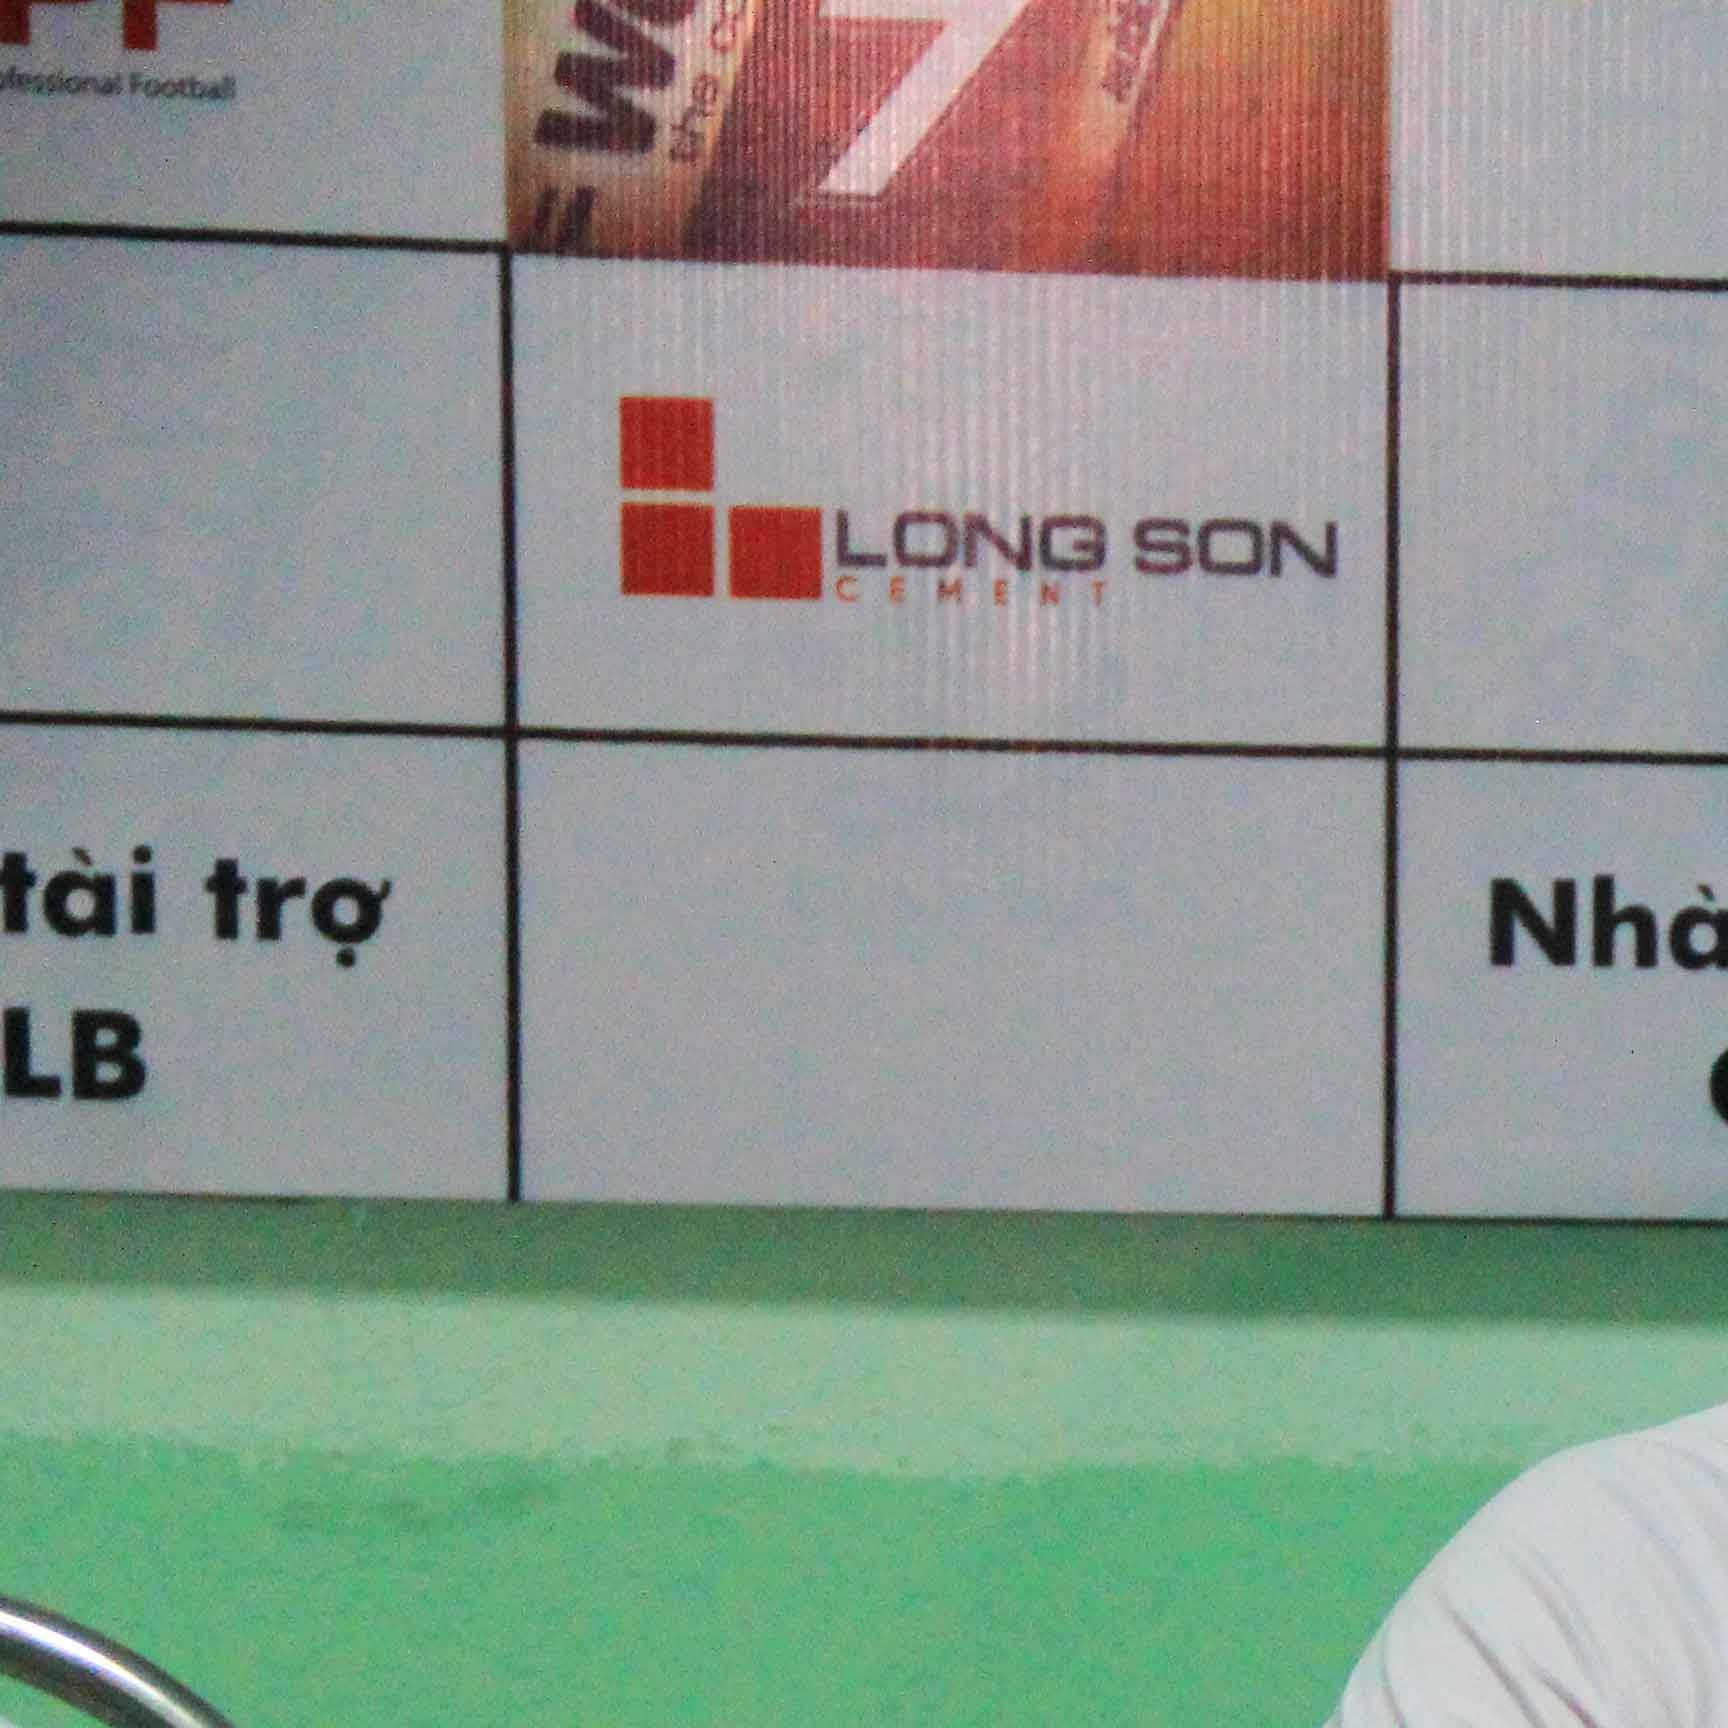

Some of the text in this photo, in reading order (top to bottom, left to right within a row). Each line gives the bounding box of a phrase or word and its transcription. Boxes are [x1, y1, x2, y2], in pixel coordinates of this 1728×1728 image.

[836, 510, 1339, 579] LONG SON
[836, 576, 1108, 607] CEMENT
[0, 846, 392, 968] tài trợ
[3, 1007, 147, 1101] LB
